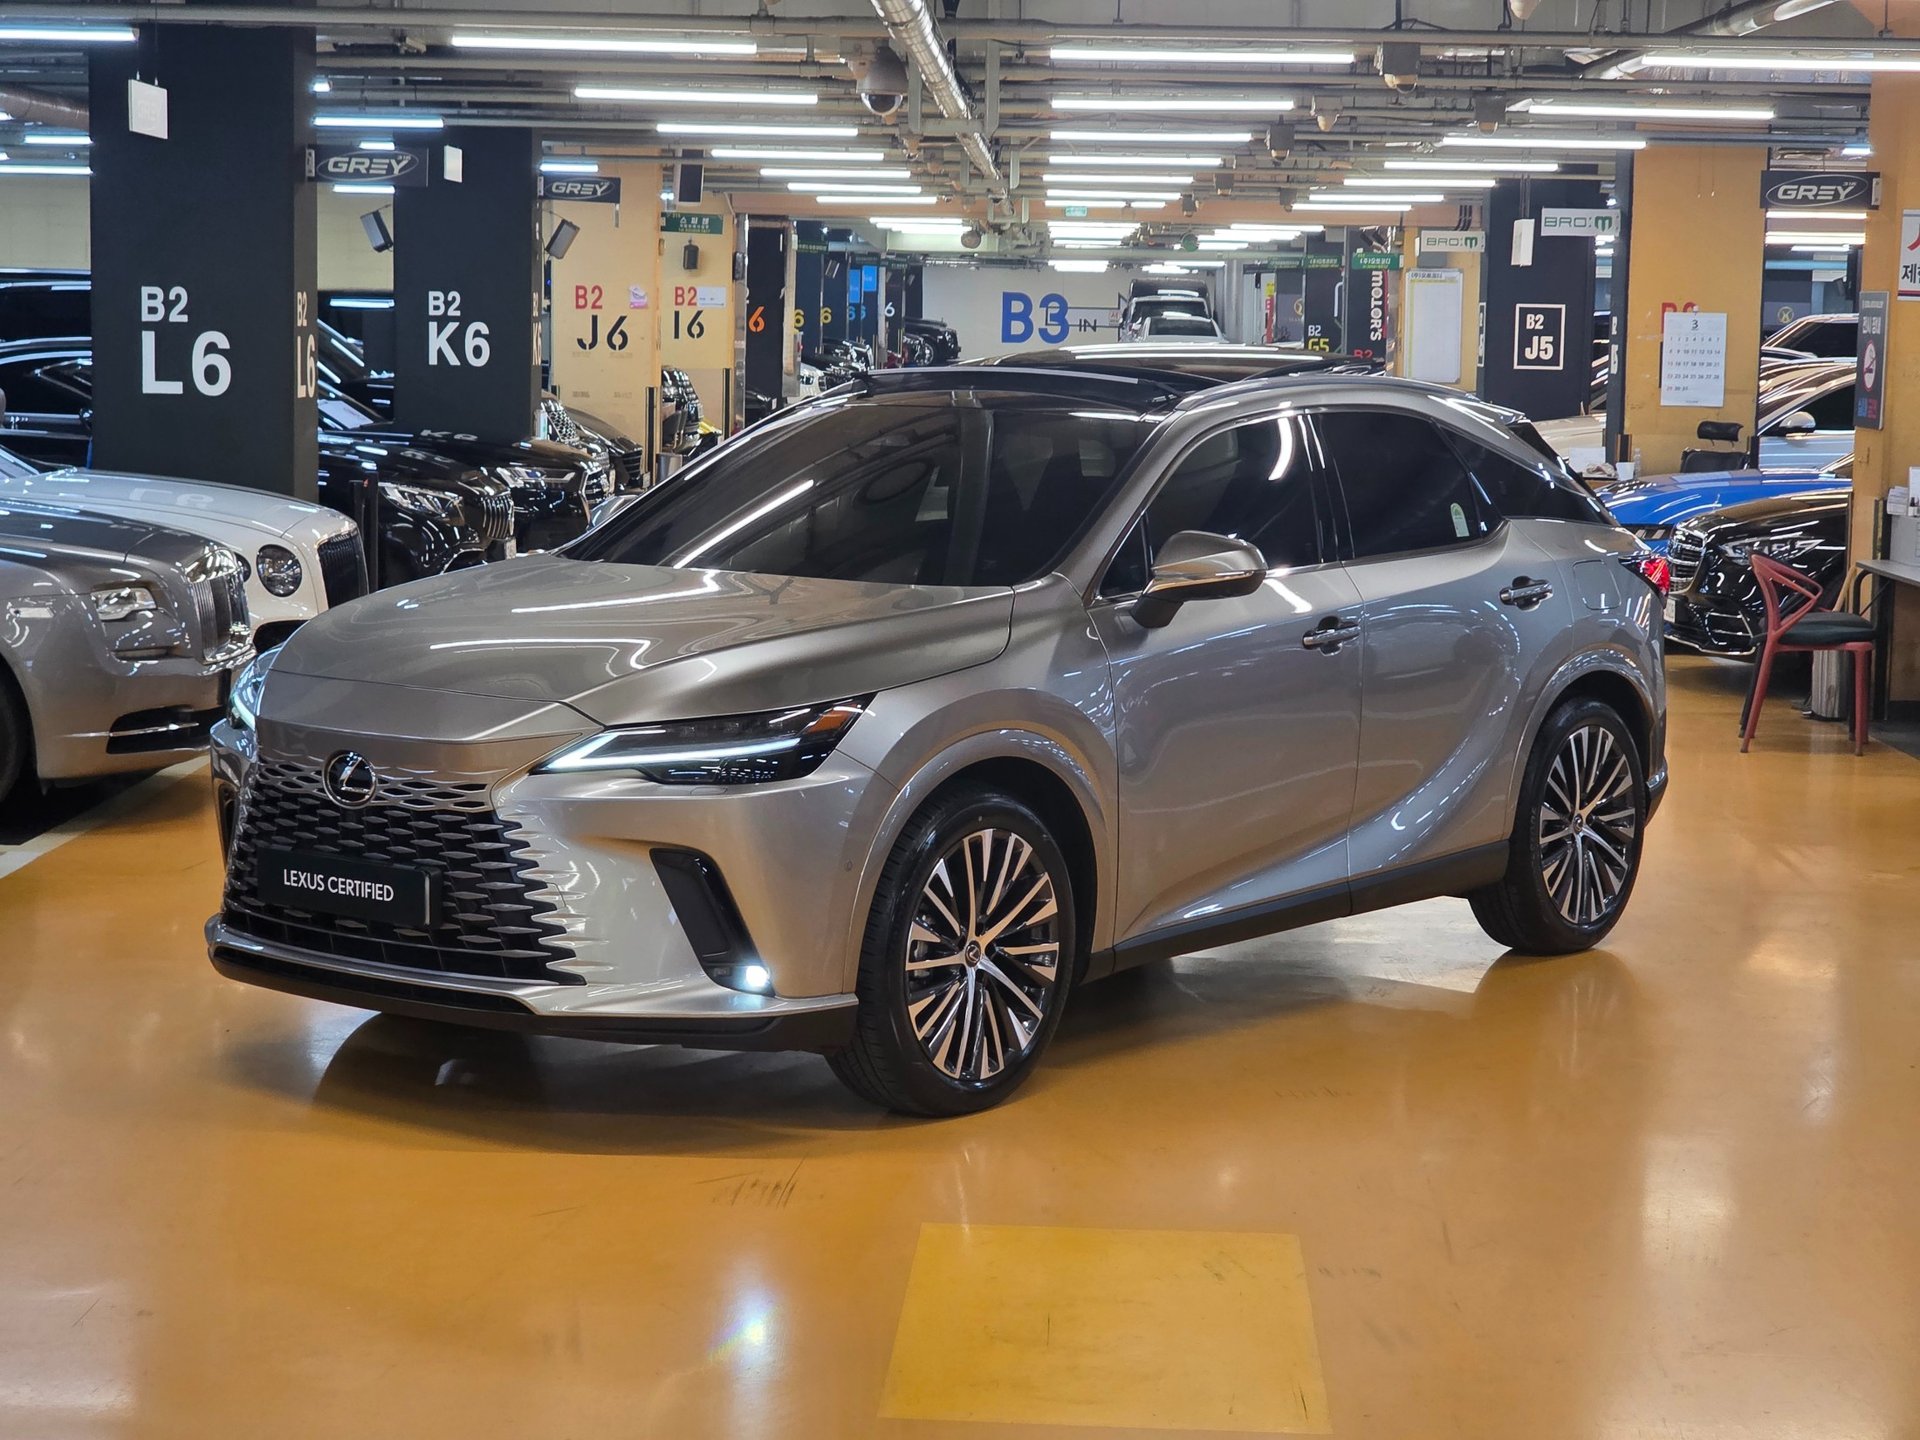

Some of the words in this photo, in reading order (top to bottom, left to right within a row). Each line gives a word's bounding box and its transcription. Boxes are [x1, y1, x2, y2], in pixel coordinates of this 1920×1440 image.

[327, 156, 411, 175] GREY
[551, 181, 610, 196] GREY
[1777, 184, 1855, 200] GREY
[1902, 264, 1920, 284] 제
[141, 286, 189, 323] B2
[428, 291, 461, 316] B2
[575, 285, 603, 309] B2
[674, 286, 697, 306] B2
[297, 291, 307, 327] B2
[748, 306, 765, 332] 6
[821, 307, 832, 324] 6
[884, 302, 895, 317] 6
[1001, 291, 1069, 344] B3
[576, 315, 628, 351] J6
[1079, 319, 1097, 332] IN
[1308, 325, 1322, 337] B2
[1526, 314, 1544, 330] B2
[428, 322, 491, 366] K6
[1525, 335, 1554, 360] J5
[141, 331, 232, 396] L6
[297, 334, 316, 398] L6
[283, 868, 325, 891] LEXUS
[327, 876, 394, 902] CERTIFIED
